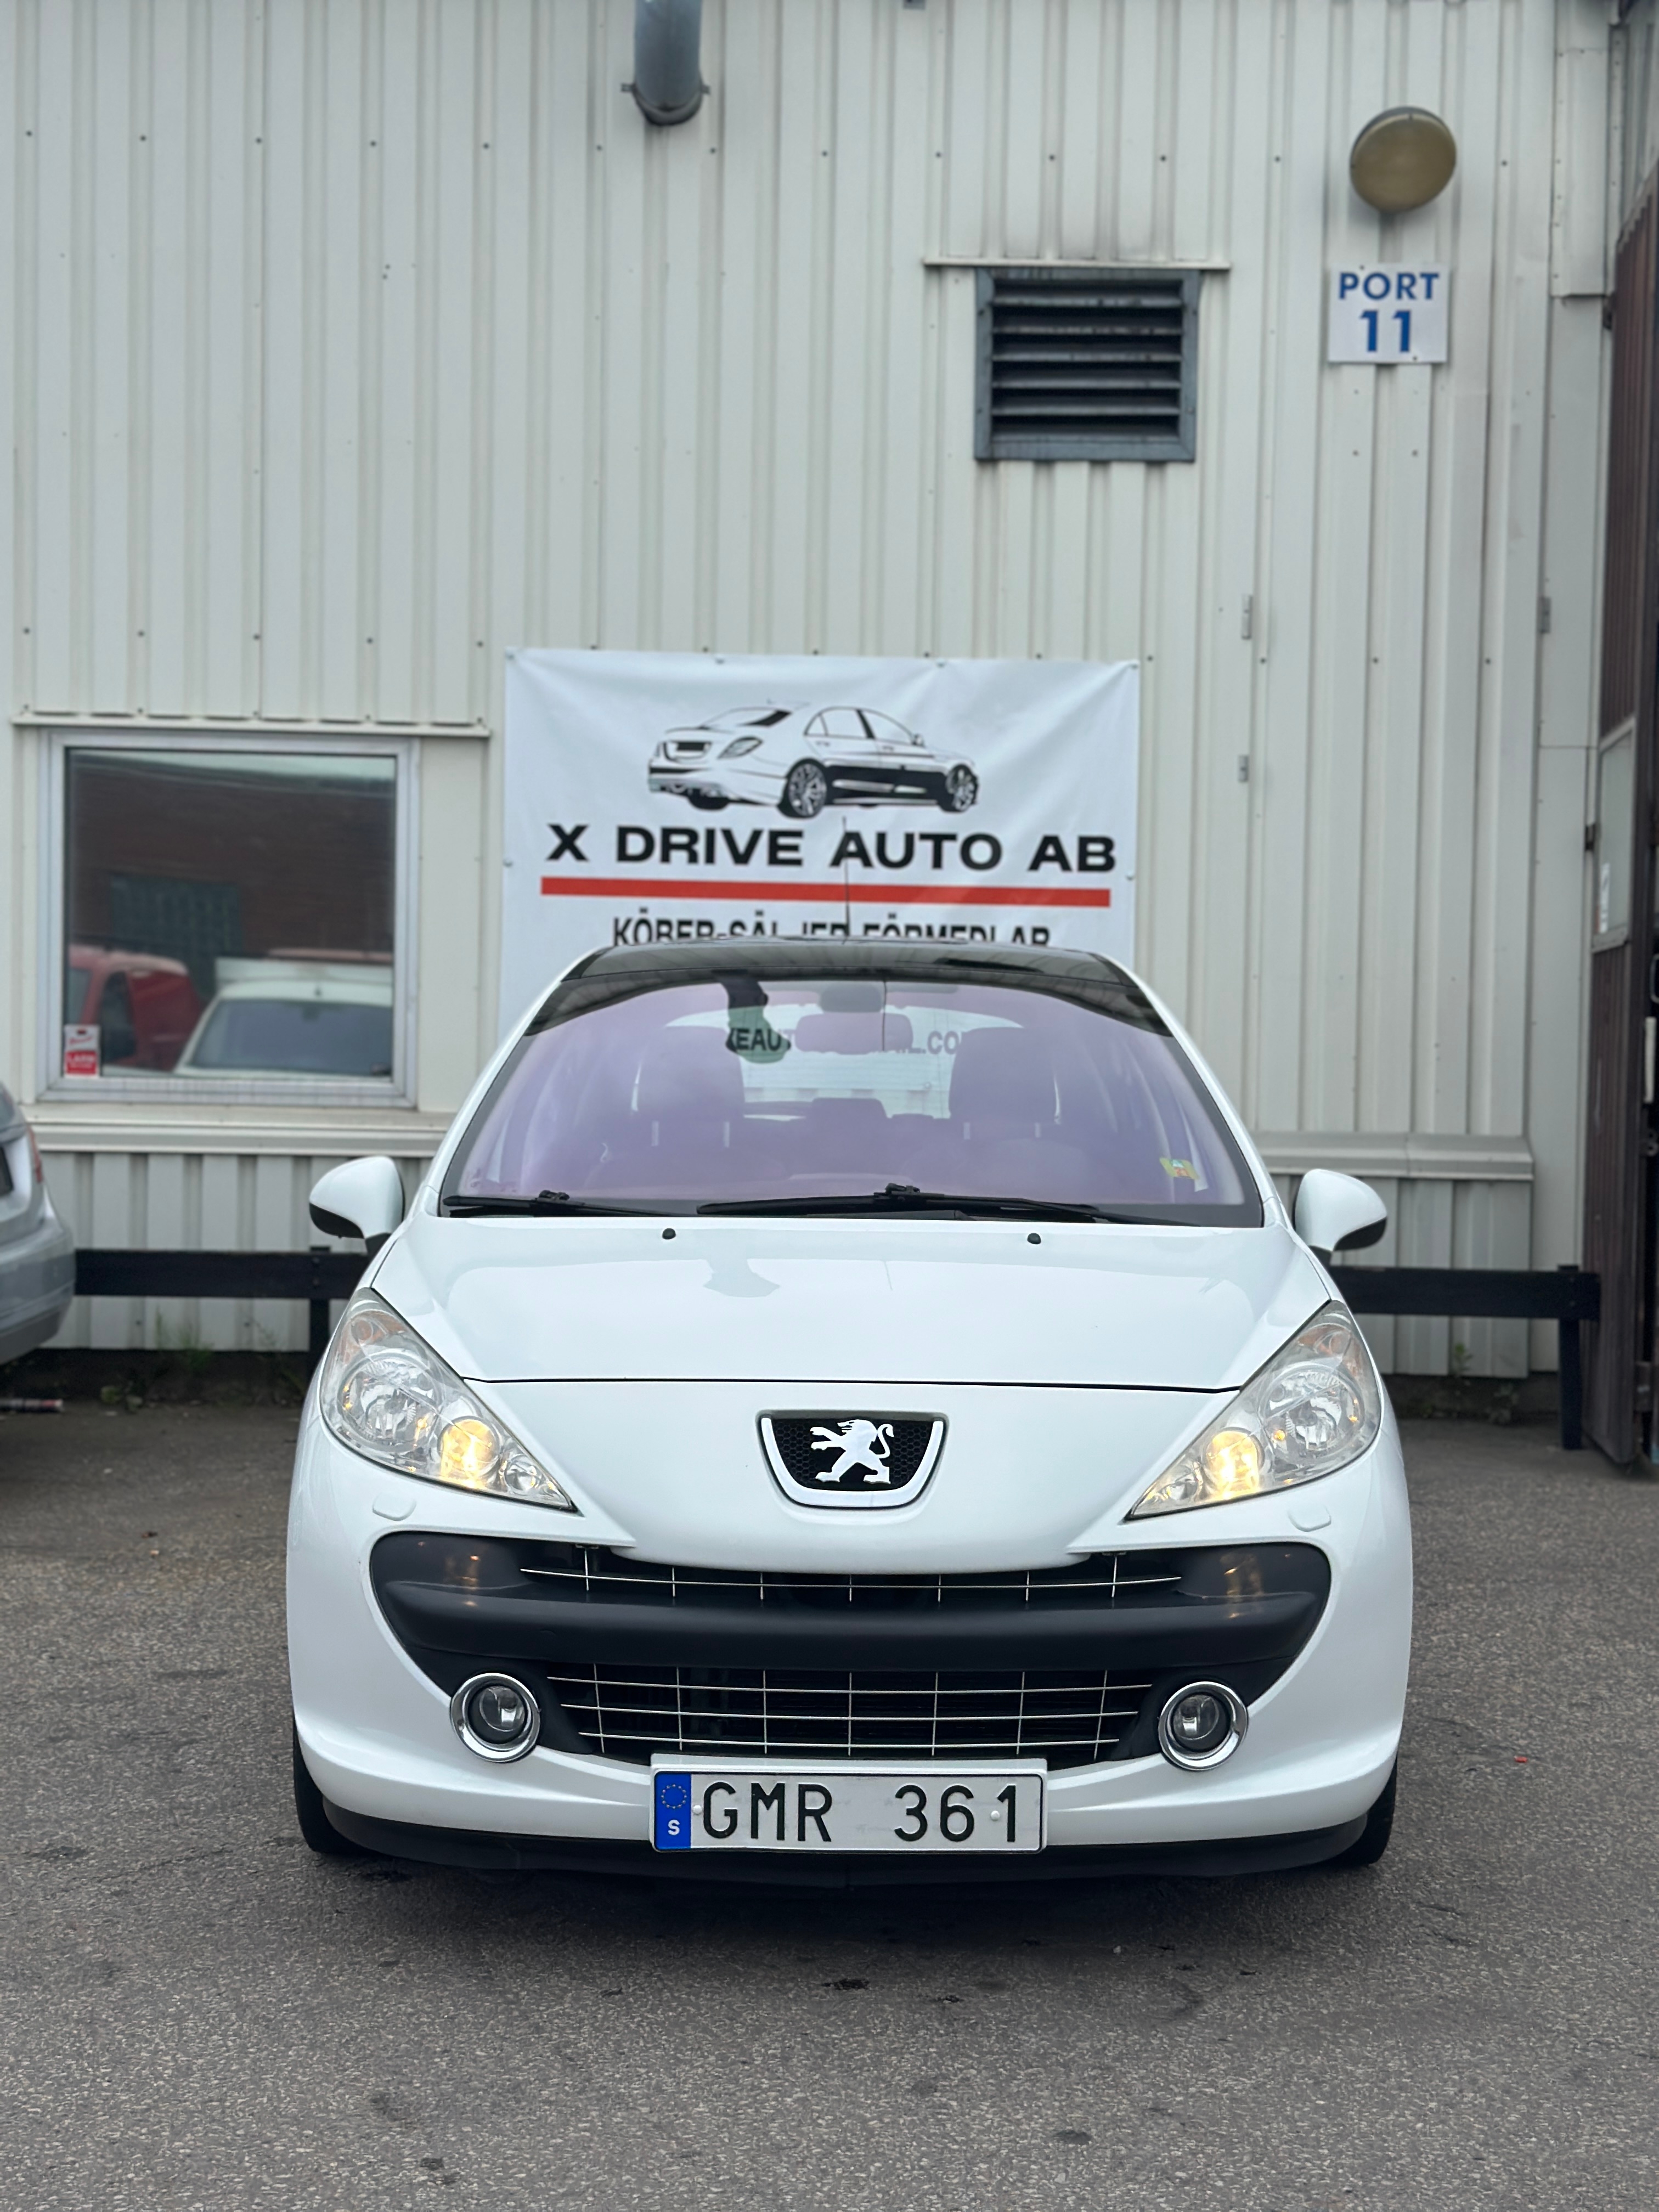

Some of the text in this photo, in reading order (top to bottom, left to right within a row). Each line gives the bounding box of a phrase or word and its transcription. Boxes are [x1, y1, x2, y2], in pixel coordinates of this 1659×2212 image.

[1339, 272, 1440, 300] PORT
[1359, 309, 1411, 352] 11
[547, 824, 1116, 873] X DRIVE AUTO AB
[668, 1781, 1016, 1843] S GMR 361
